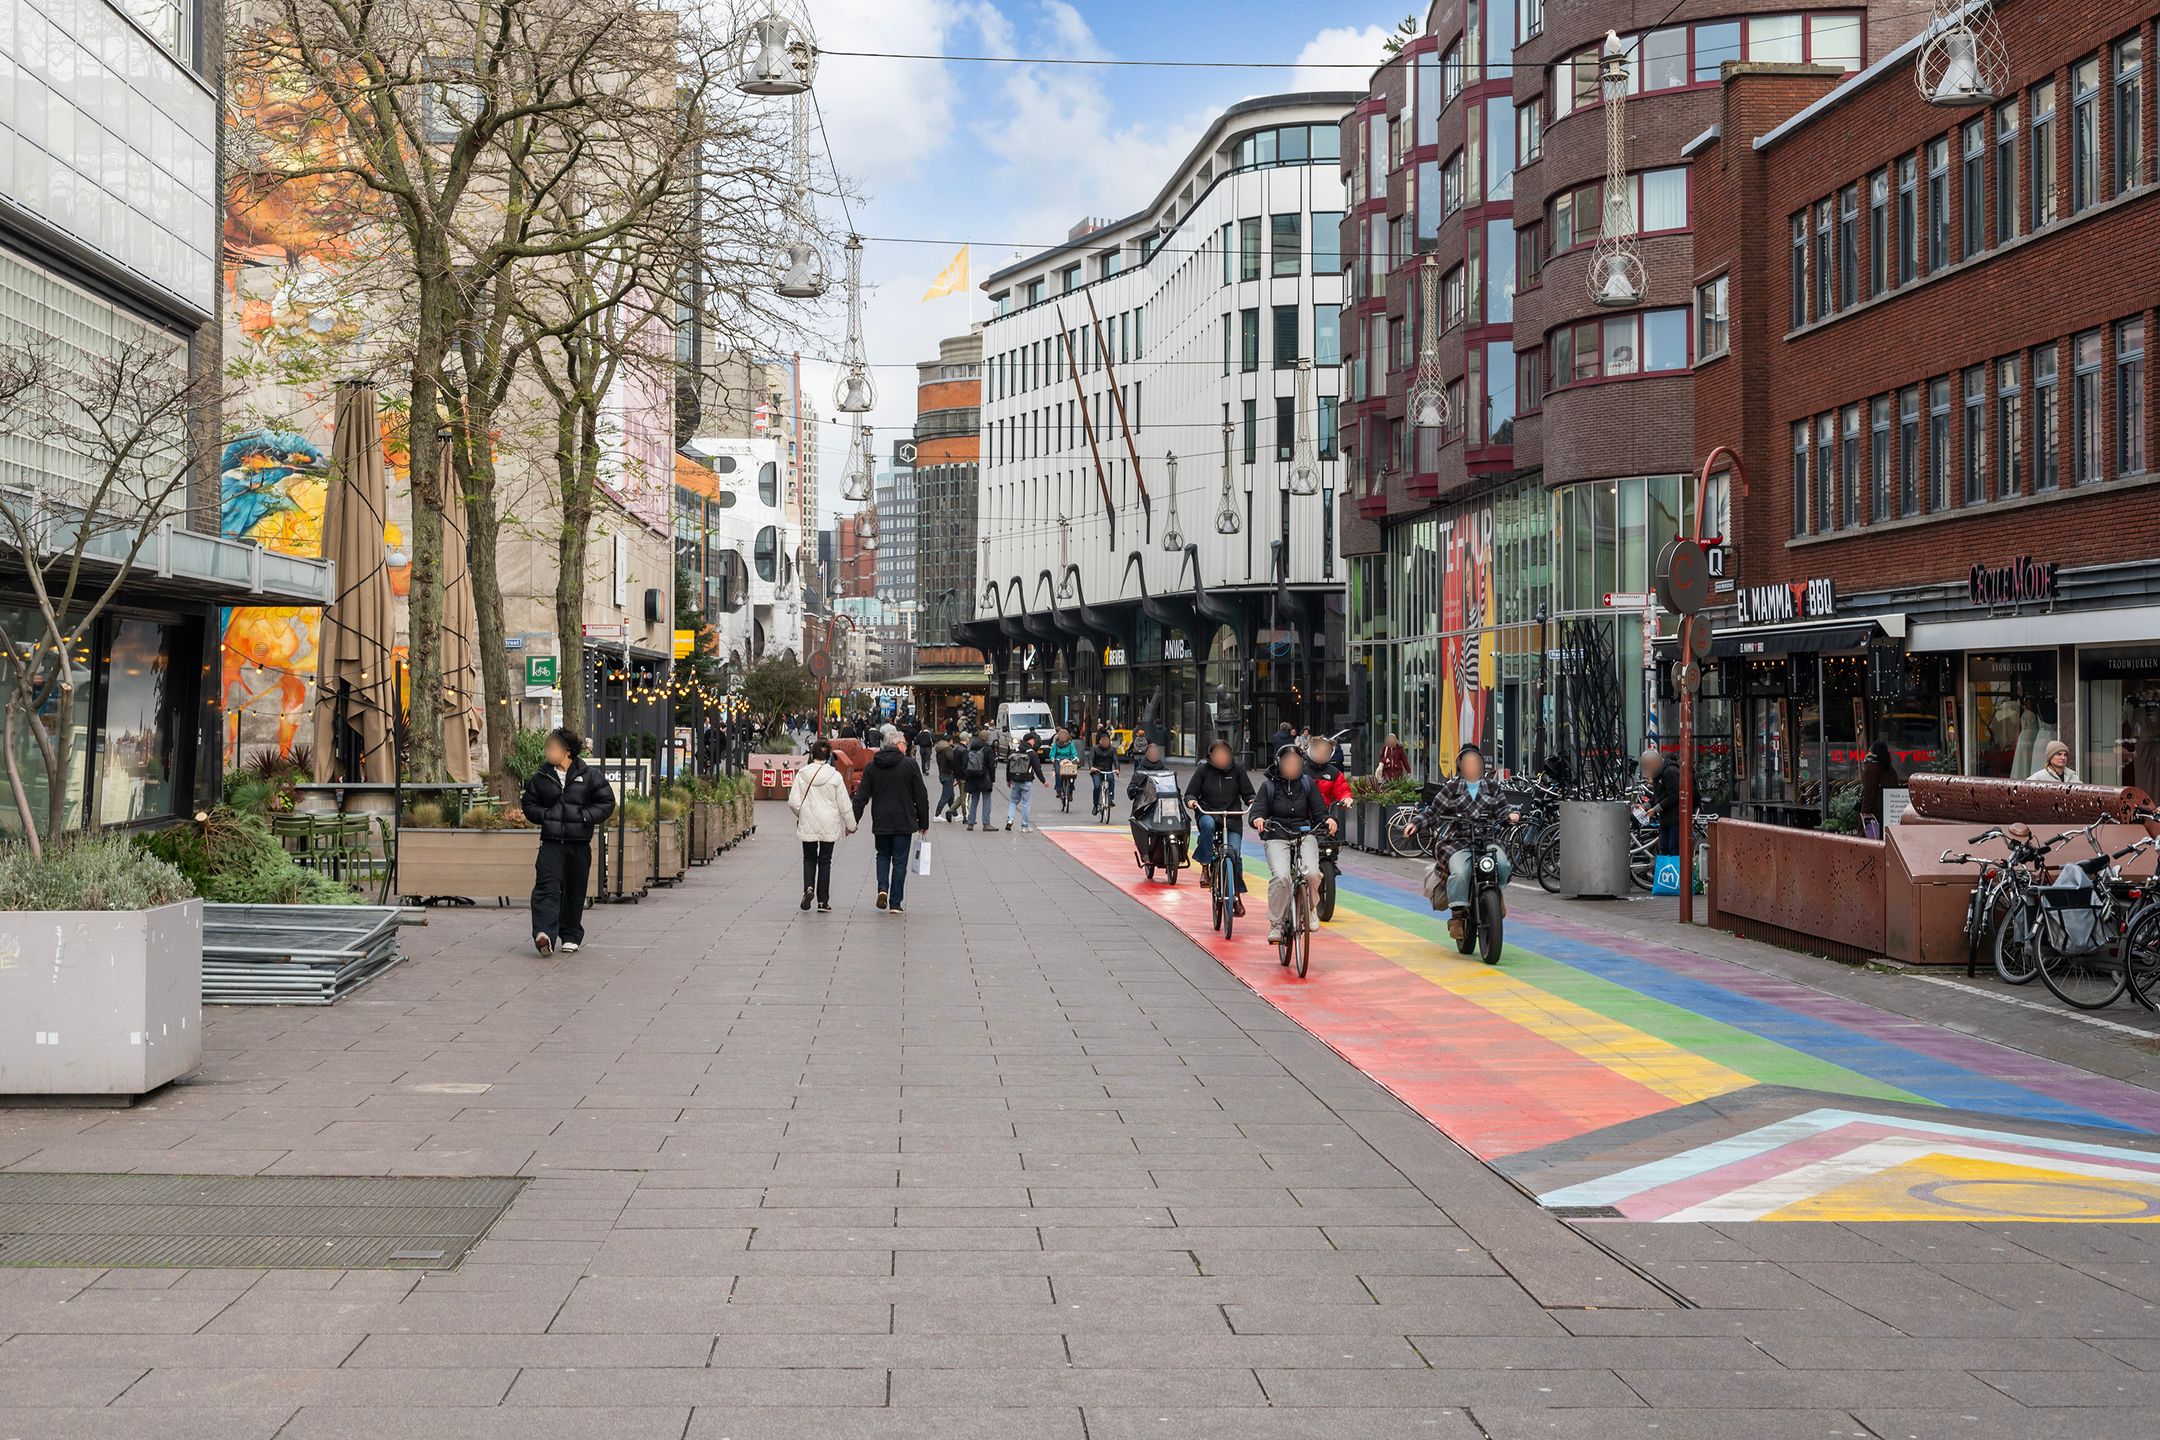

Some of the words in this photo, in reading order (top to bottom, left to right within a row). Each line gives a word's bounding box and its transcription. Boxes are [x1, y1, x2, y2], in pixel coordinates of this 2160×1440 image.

[1674, 554, 1693, 589] C
[1737, 588, 1750, 622] EL
[1752, 583, 1793, 621] MAMMA
[1808, 578, 1833, 616] BBQ
[1109, 649, 1126, 665] BEVER
[1164, 639, 1185, 659] ANWB
[1992, 662, 2032, 673] AVONDJURKEN
[2109, 658, 2158, 670] TROUWJURKEN
